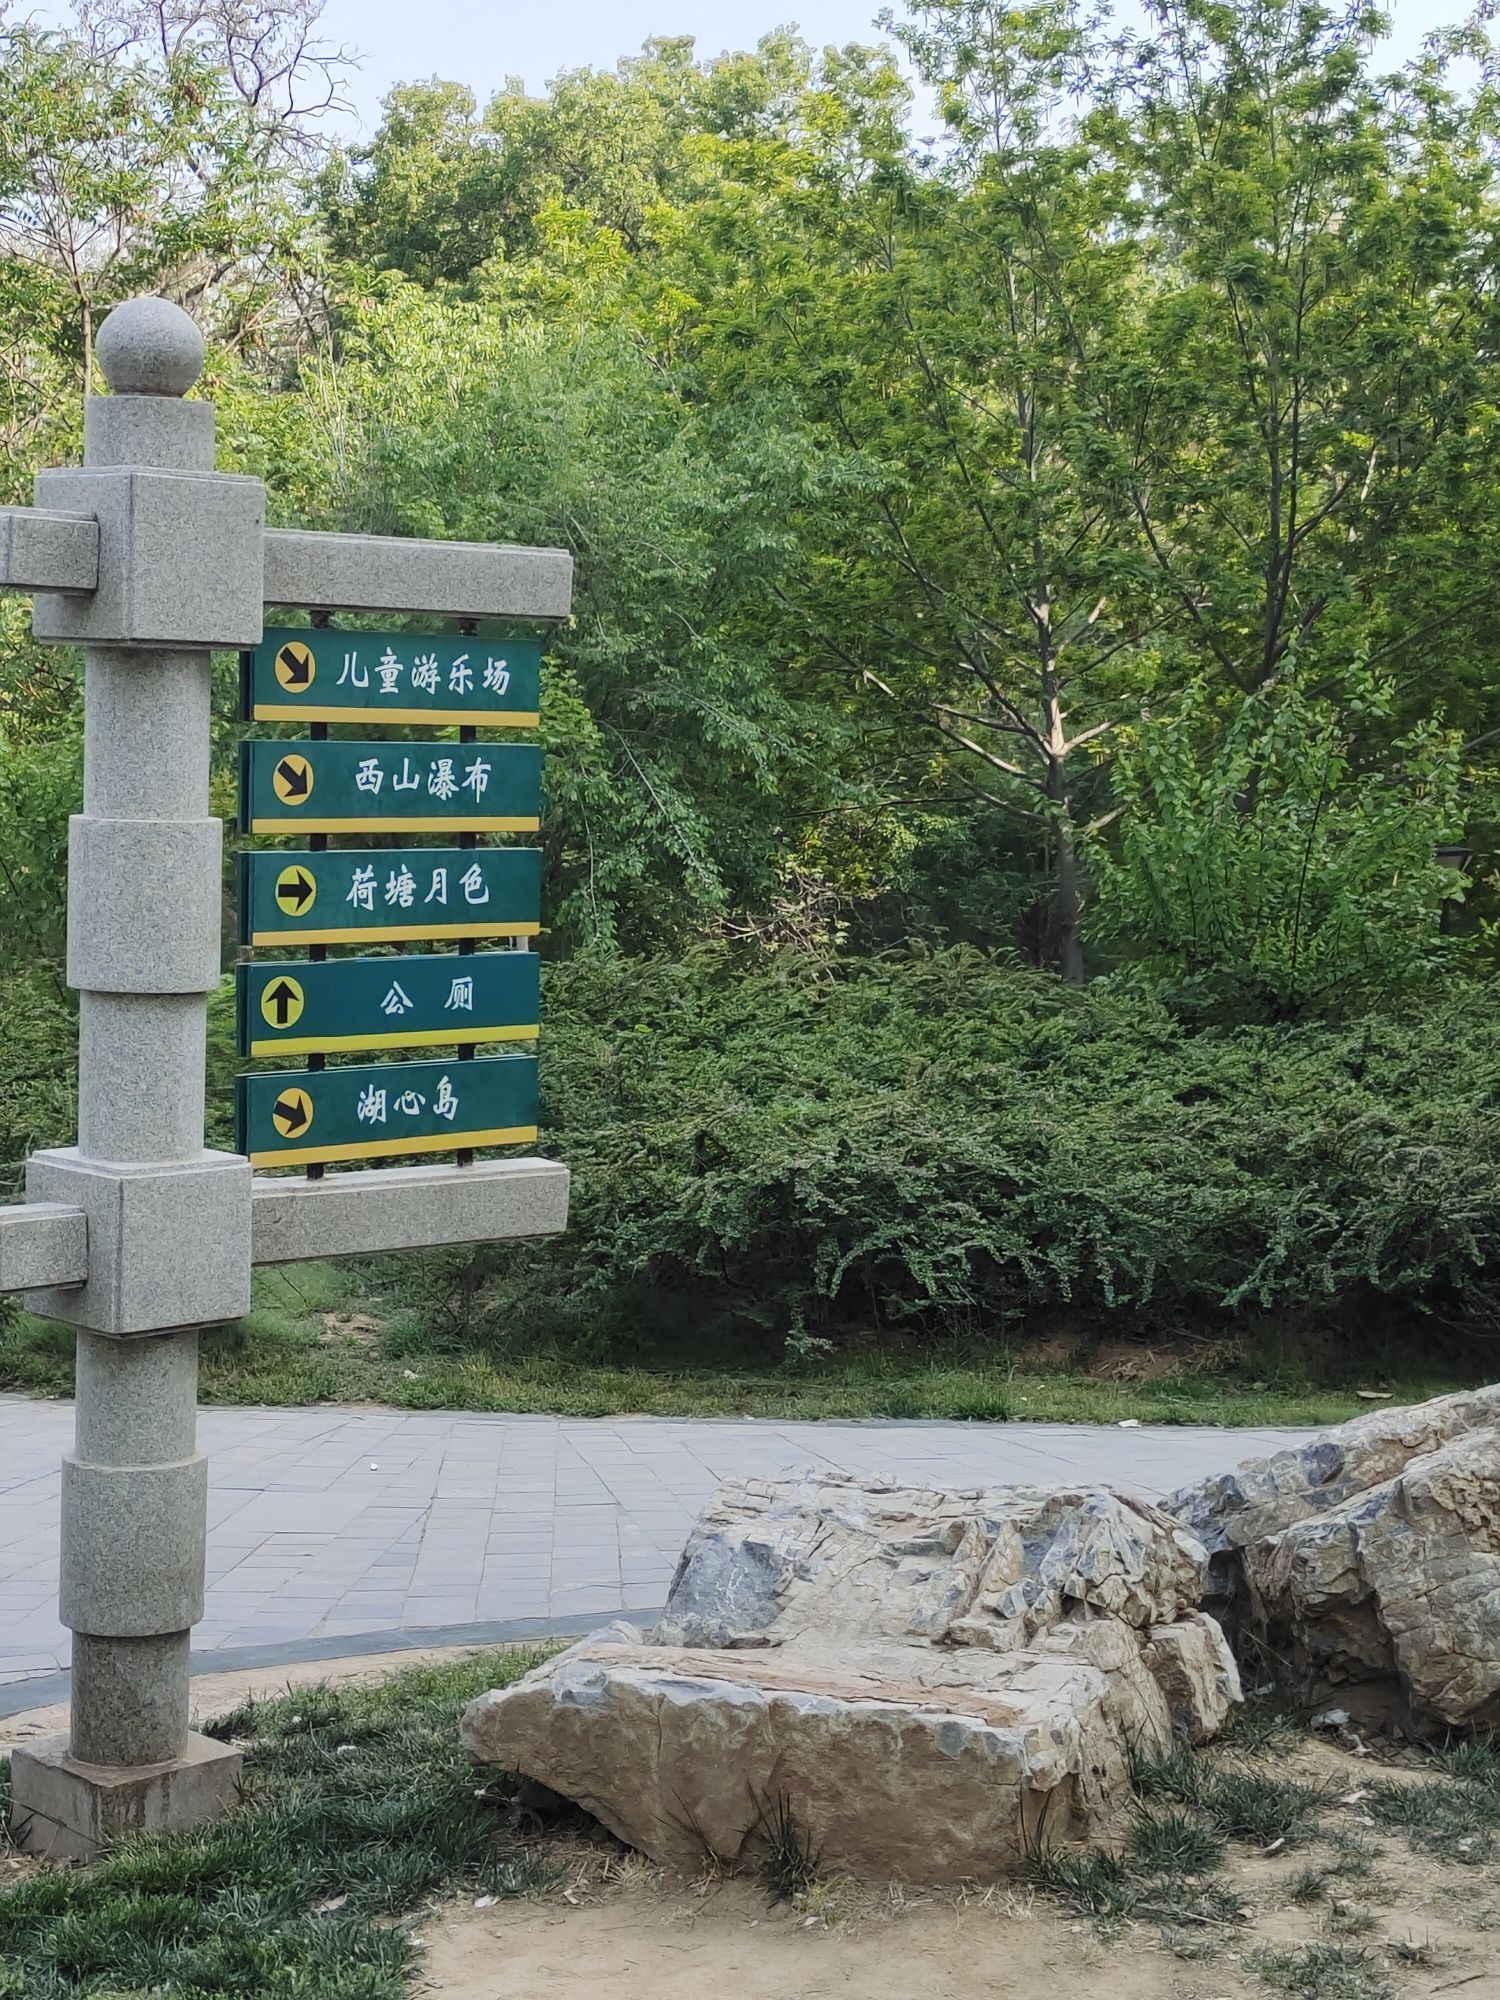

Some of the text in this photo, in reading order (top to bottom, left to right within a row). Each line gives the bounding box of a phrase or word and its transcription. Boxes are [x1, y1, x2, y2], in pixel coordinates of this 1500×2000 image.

[335, 646, 511, 696] 儿童游乐场
[355, 757, 492, 803] 西山瀑布
[345, 862, 490, 911] 荷塘月色
[380, 975, 474, 1015] 公厕
[356, 1074, 459, 1125] 湖心岛
